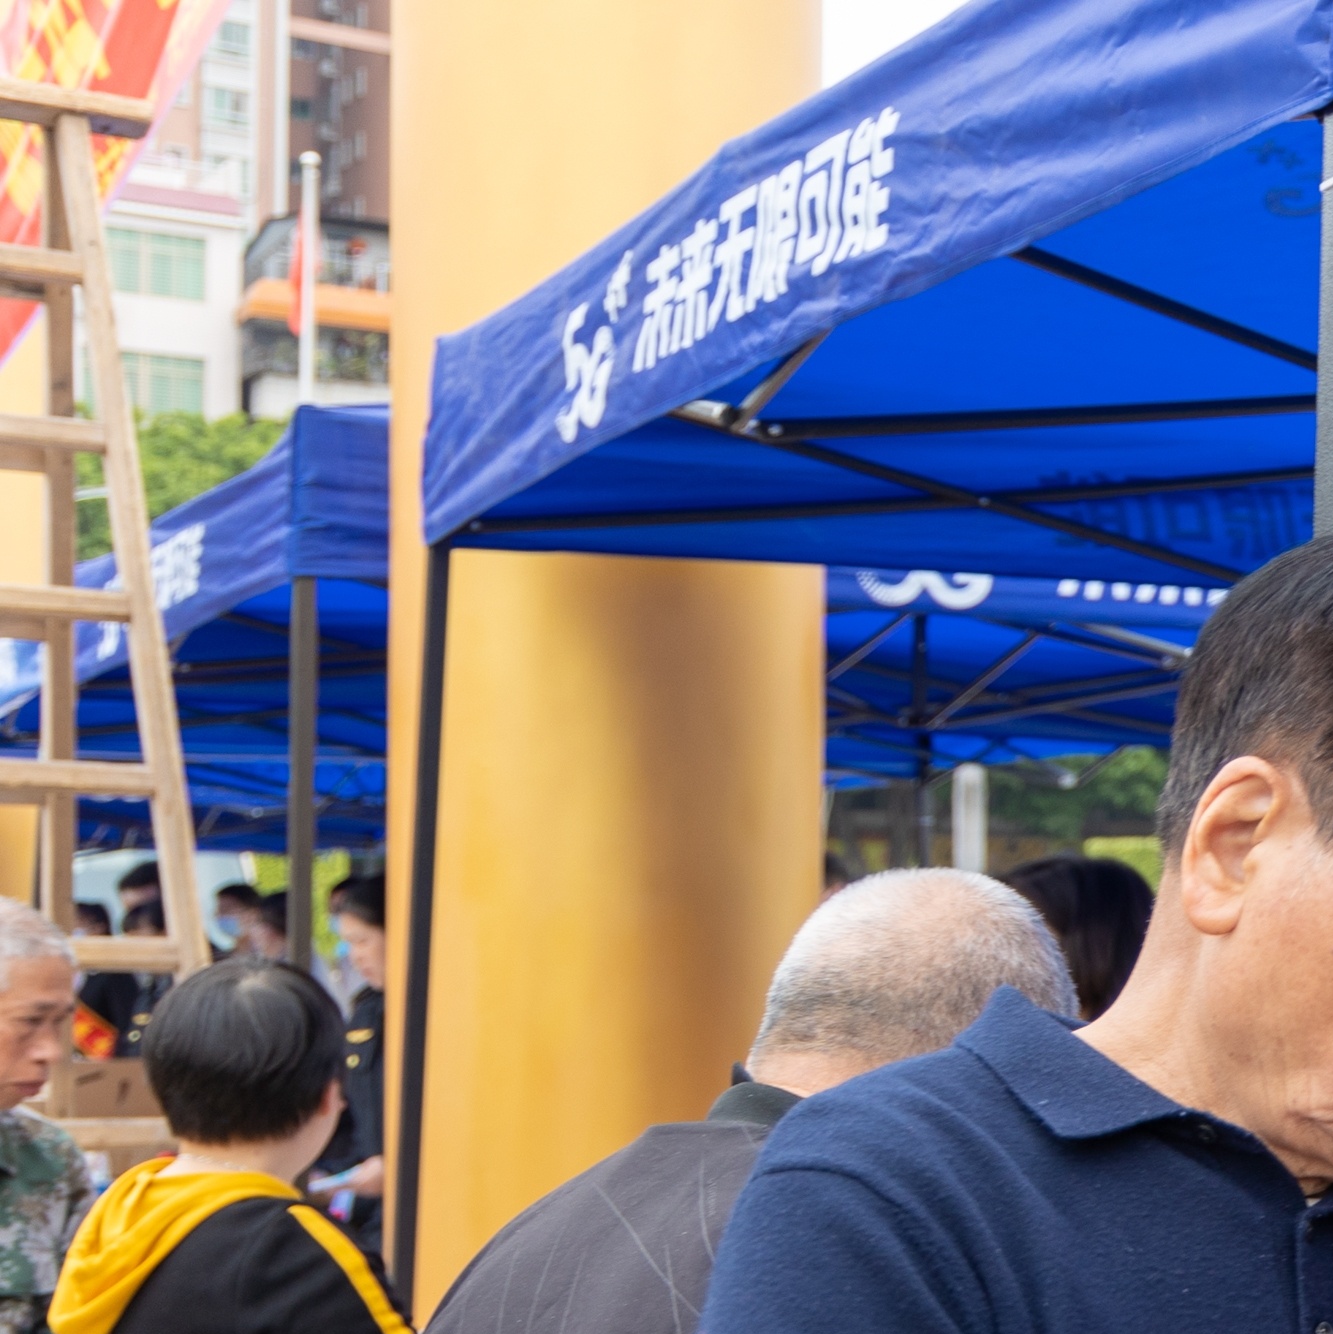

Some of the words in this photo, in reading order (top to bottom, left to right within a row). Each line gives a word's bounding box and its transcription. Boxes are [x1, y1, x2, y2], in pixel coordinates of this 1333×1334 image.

[632, 105, 901, 374] 未来无限可能
